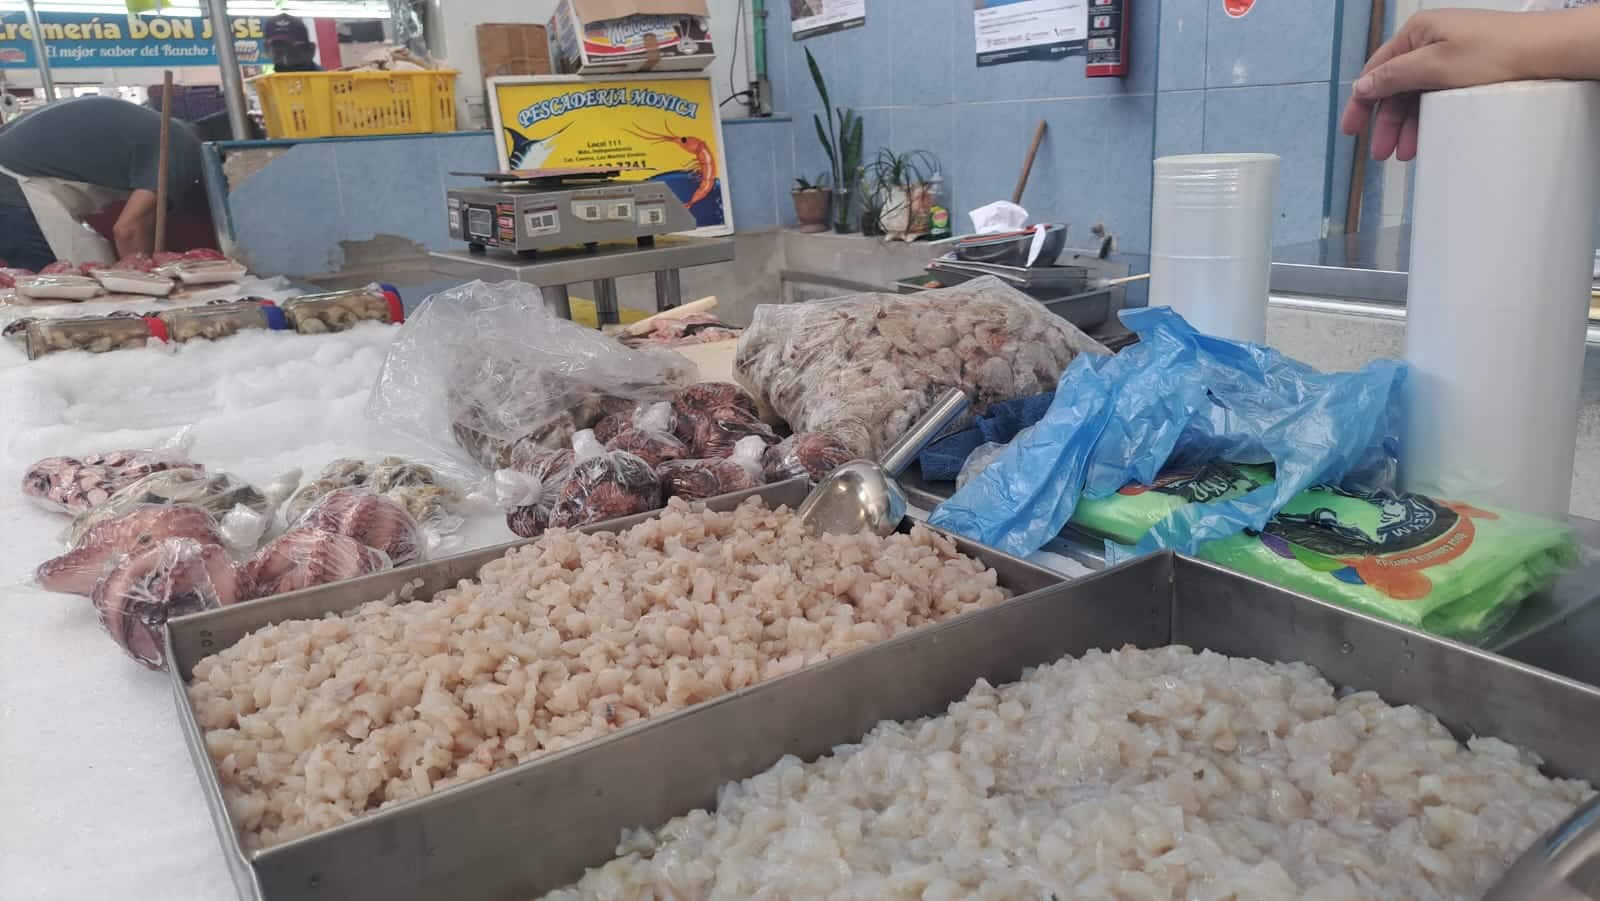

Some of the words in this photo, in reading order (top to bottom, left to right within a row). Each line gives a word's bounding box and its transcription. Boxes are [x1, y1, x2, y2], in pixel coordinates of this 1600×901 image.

[201, 17, 265, 39] JSE
[59, 45, 98, 61] mejor
[100, 45, 137, 57] sabor
[140, 45, 159, 57] del
[161, 44, 208, 57] Rancho
[631, 88, 699, 119] MONICA
